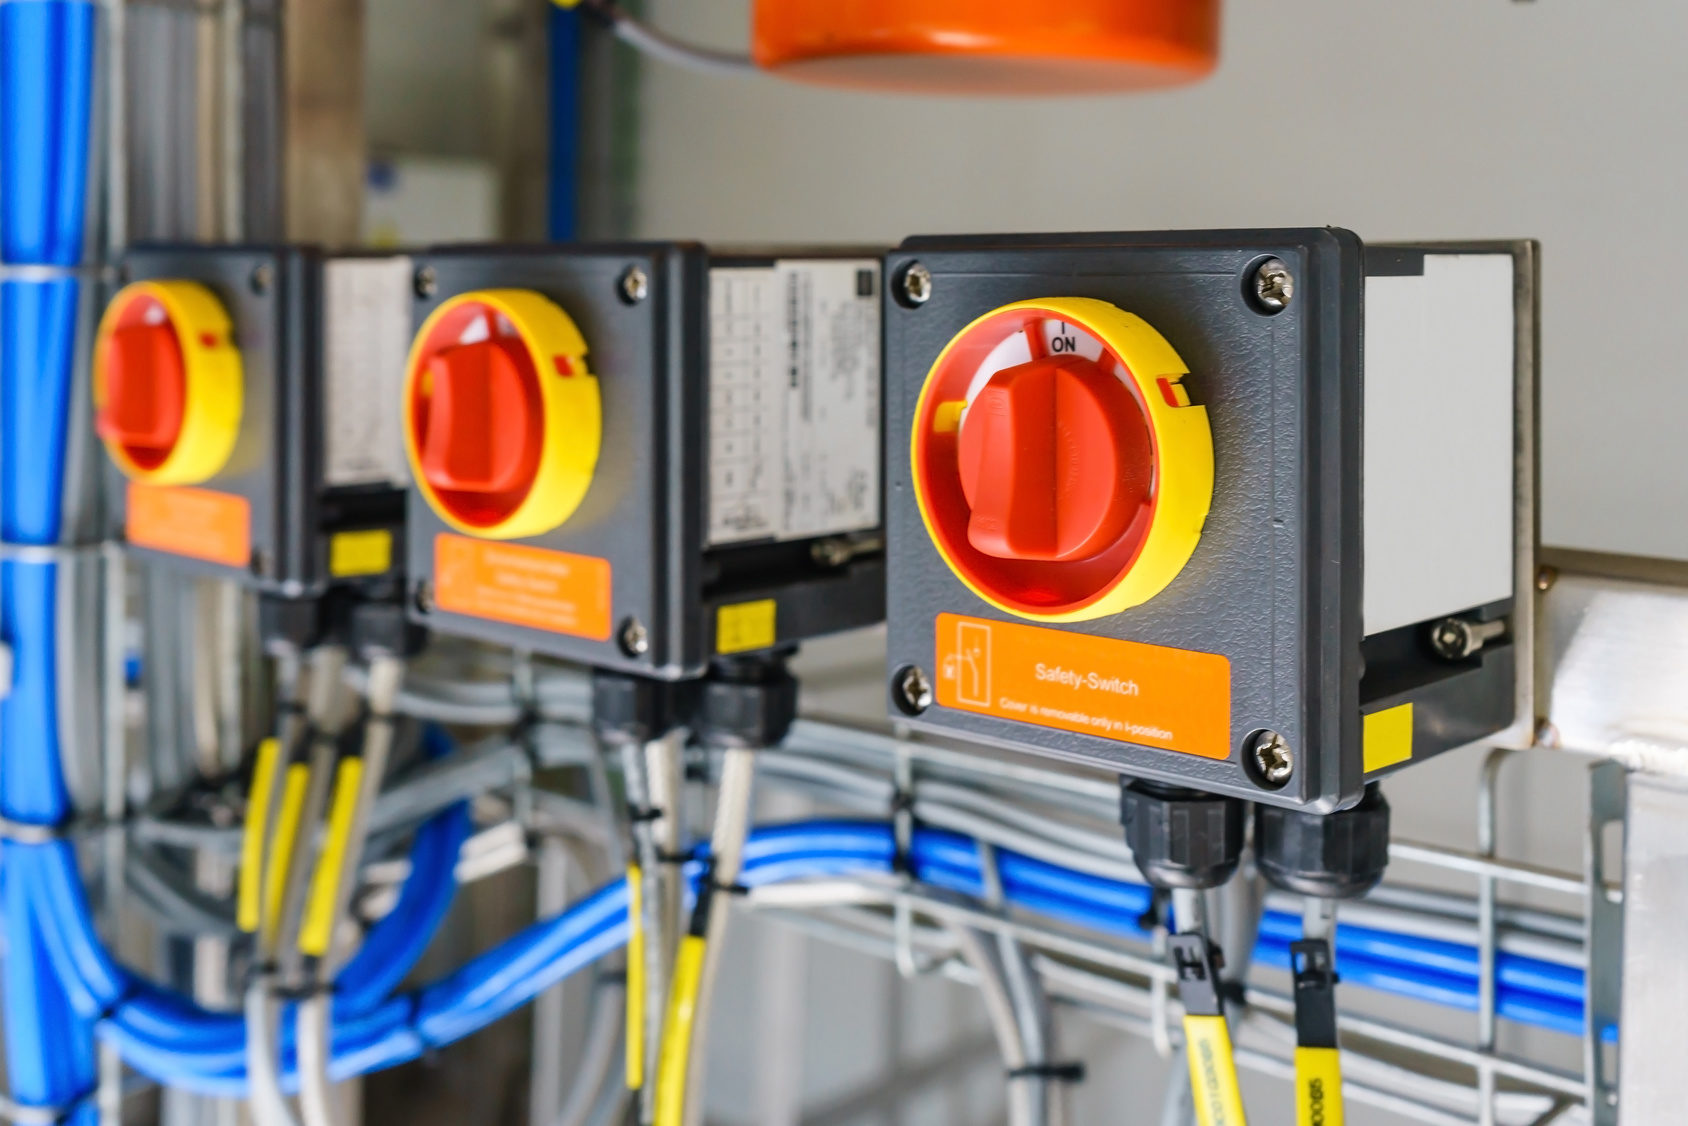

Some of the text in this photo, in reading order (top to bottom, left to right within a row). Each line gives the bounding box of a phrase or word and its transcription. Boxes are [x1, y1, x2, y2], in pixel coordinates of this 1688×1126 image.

[1052, 336, 1076, 353] ON
[1035, 663, 1139, 696] Safety-Switch
[999, 697, 1028, 712] Cover
[1030, 704, 1039, 715] is
[1040, 707, 1091, 724] removable
[1091, 716, 1113, 731] only
[1113, 721, 1122, 731] in
